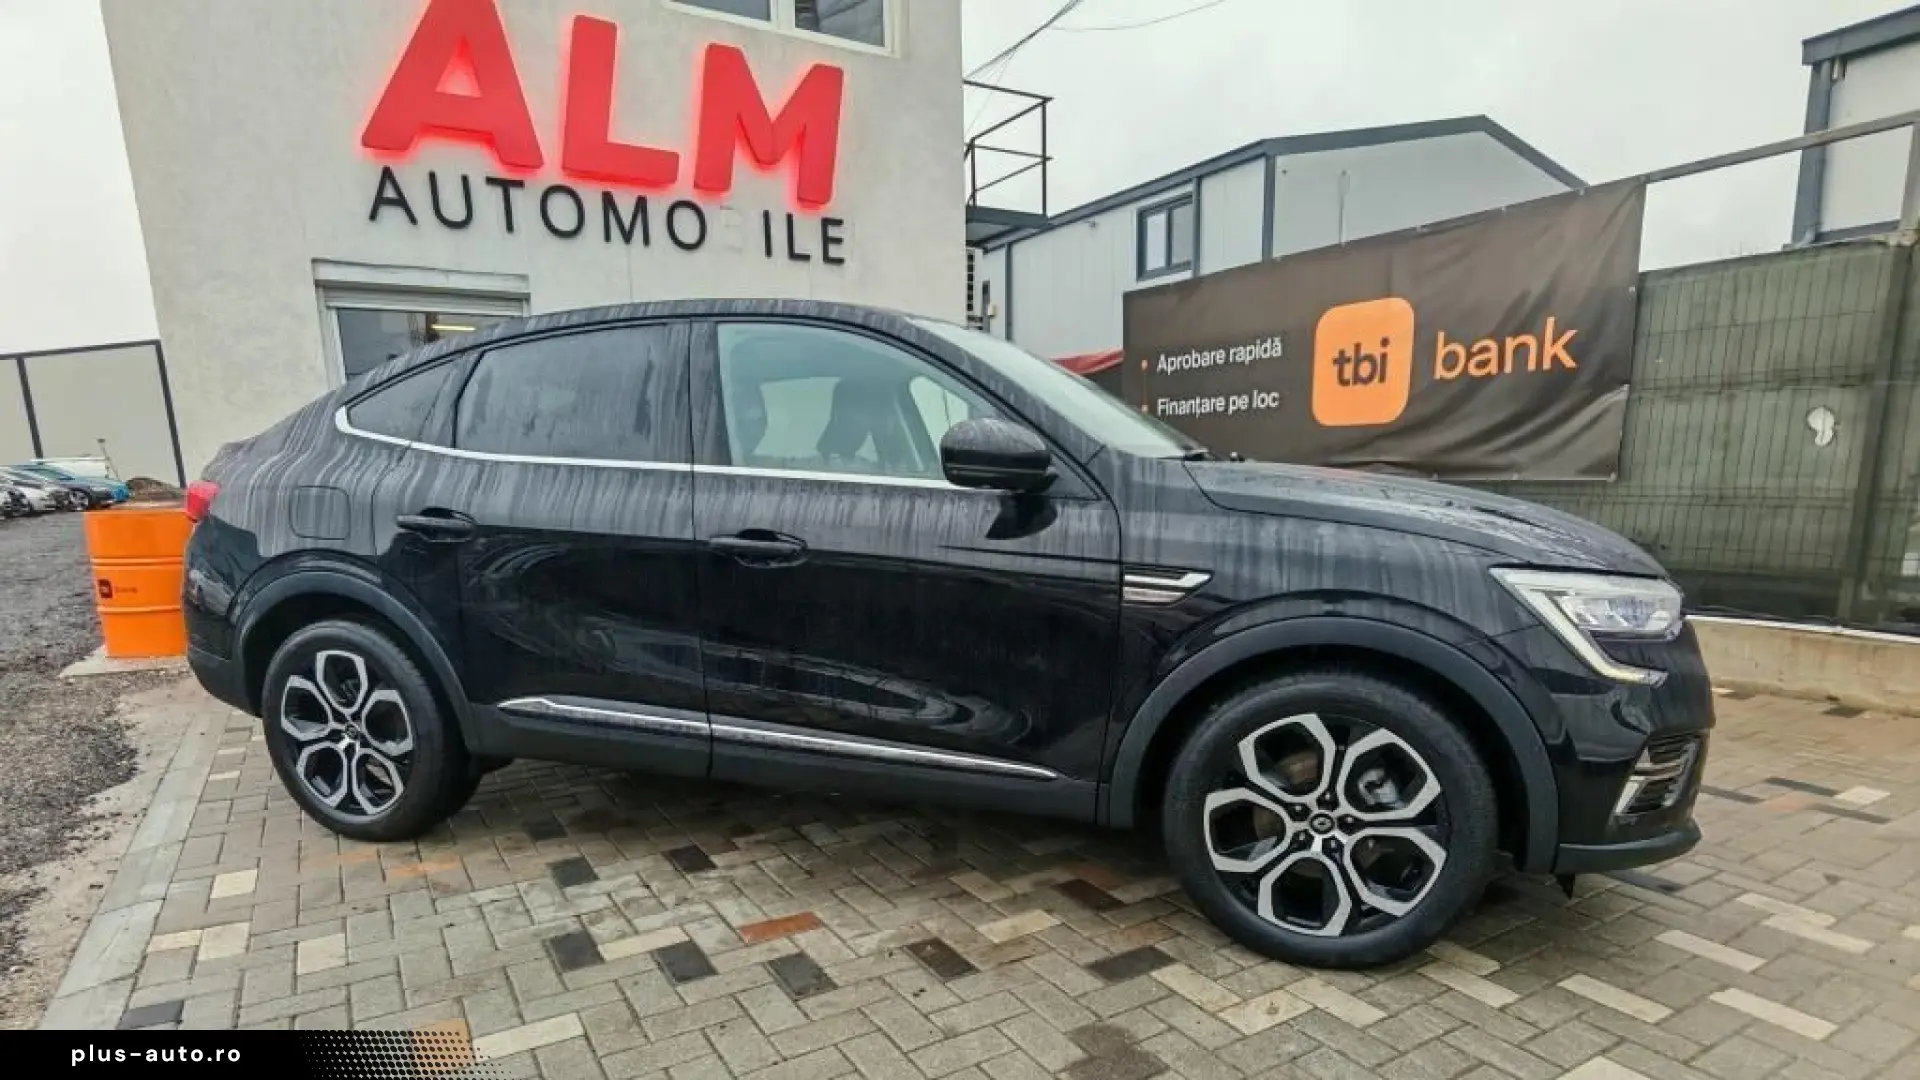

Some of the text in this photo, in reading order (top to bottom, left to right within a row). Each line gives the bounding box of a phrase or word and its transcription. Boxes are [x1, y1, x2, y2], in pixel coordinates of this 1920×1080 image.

[361, 0, 844, 207] ALM
[1157, 337, 1281, 375] Aprobare rapidă
[1332, 316, 1577, 387] tbi bank
[1228, 394, 1249, 416] pe
[1252, 389, 1280, 410] loc
